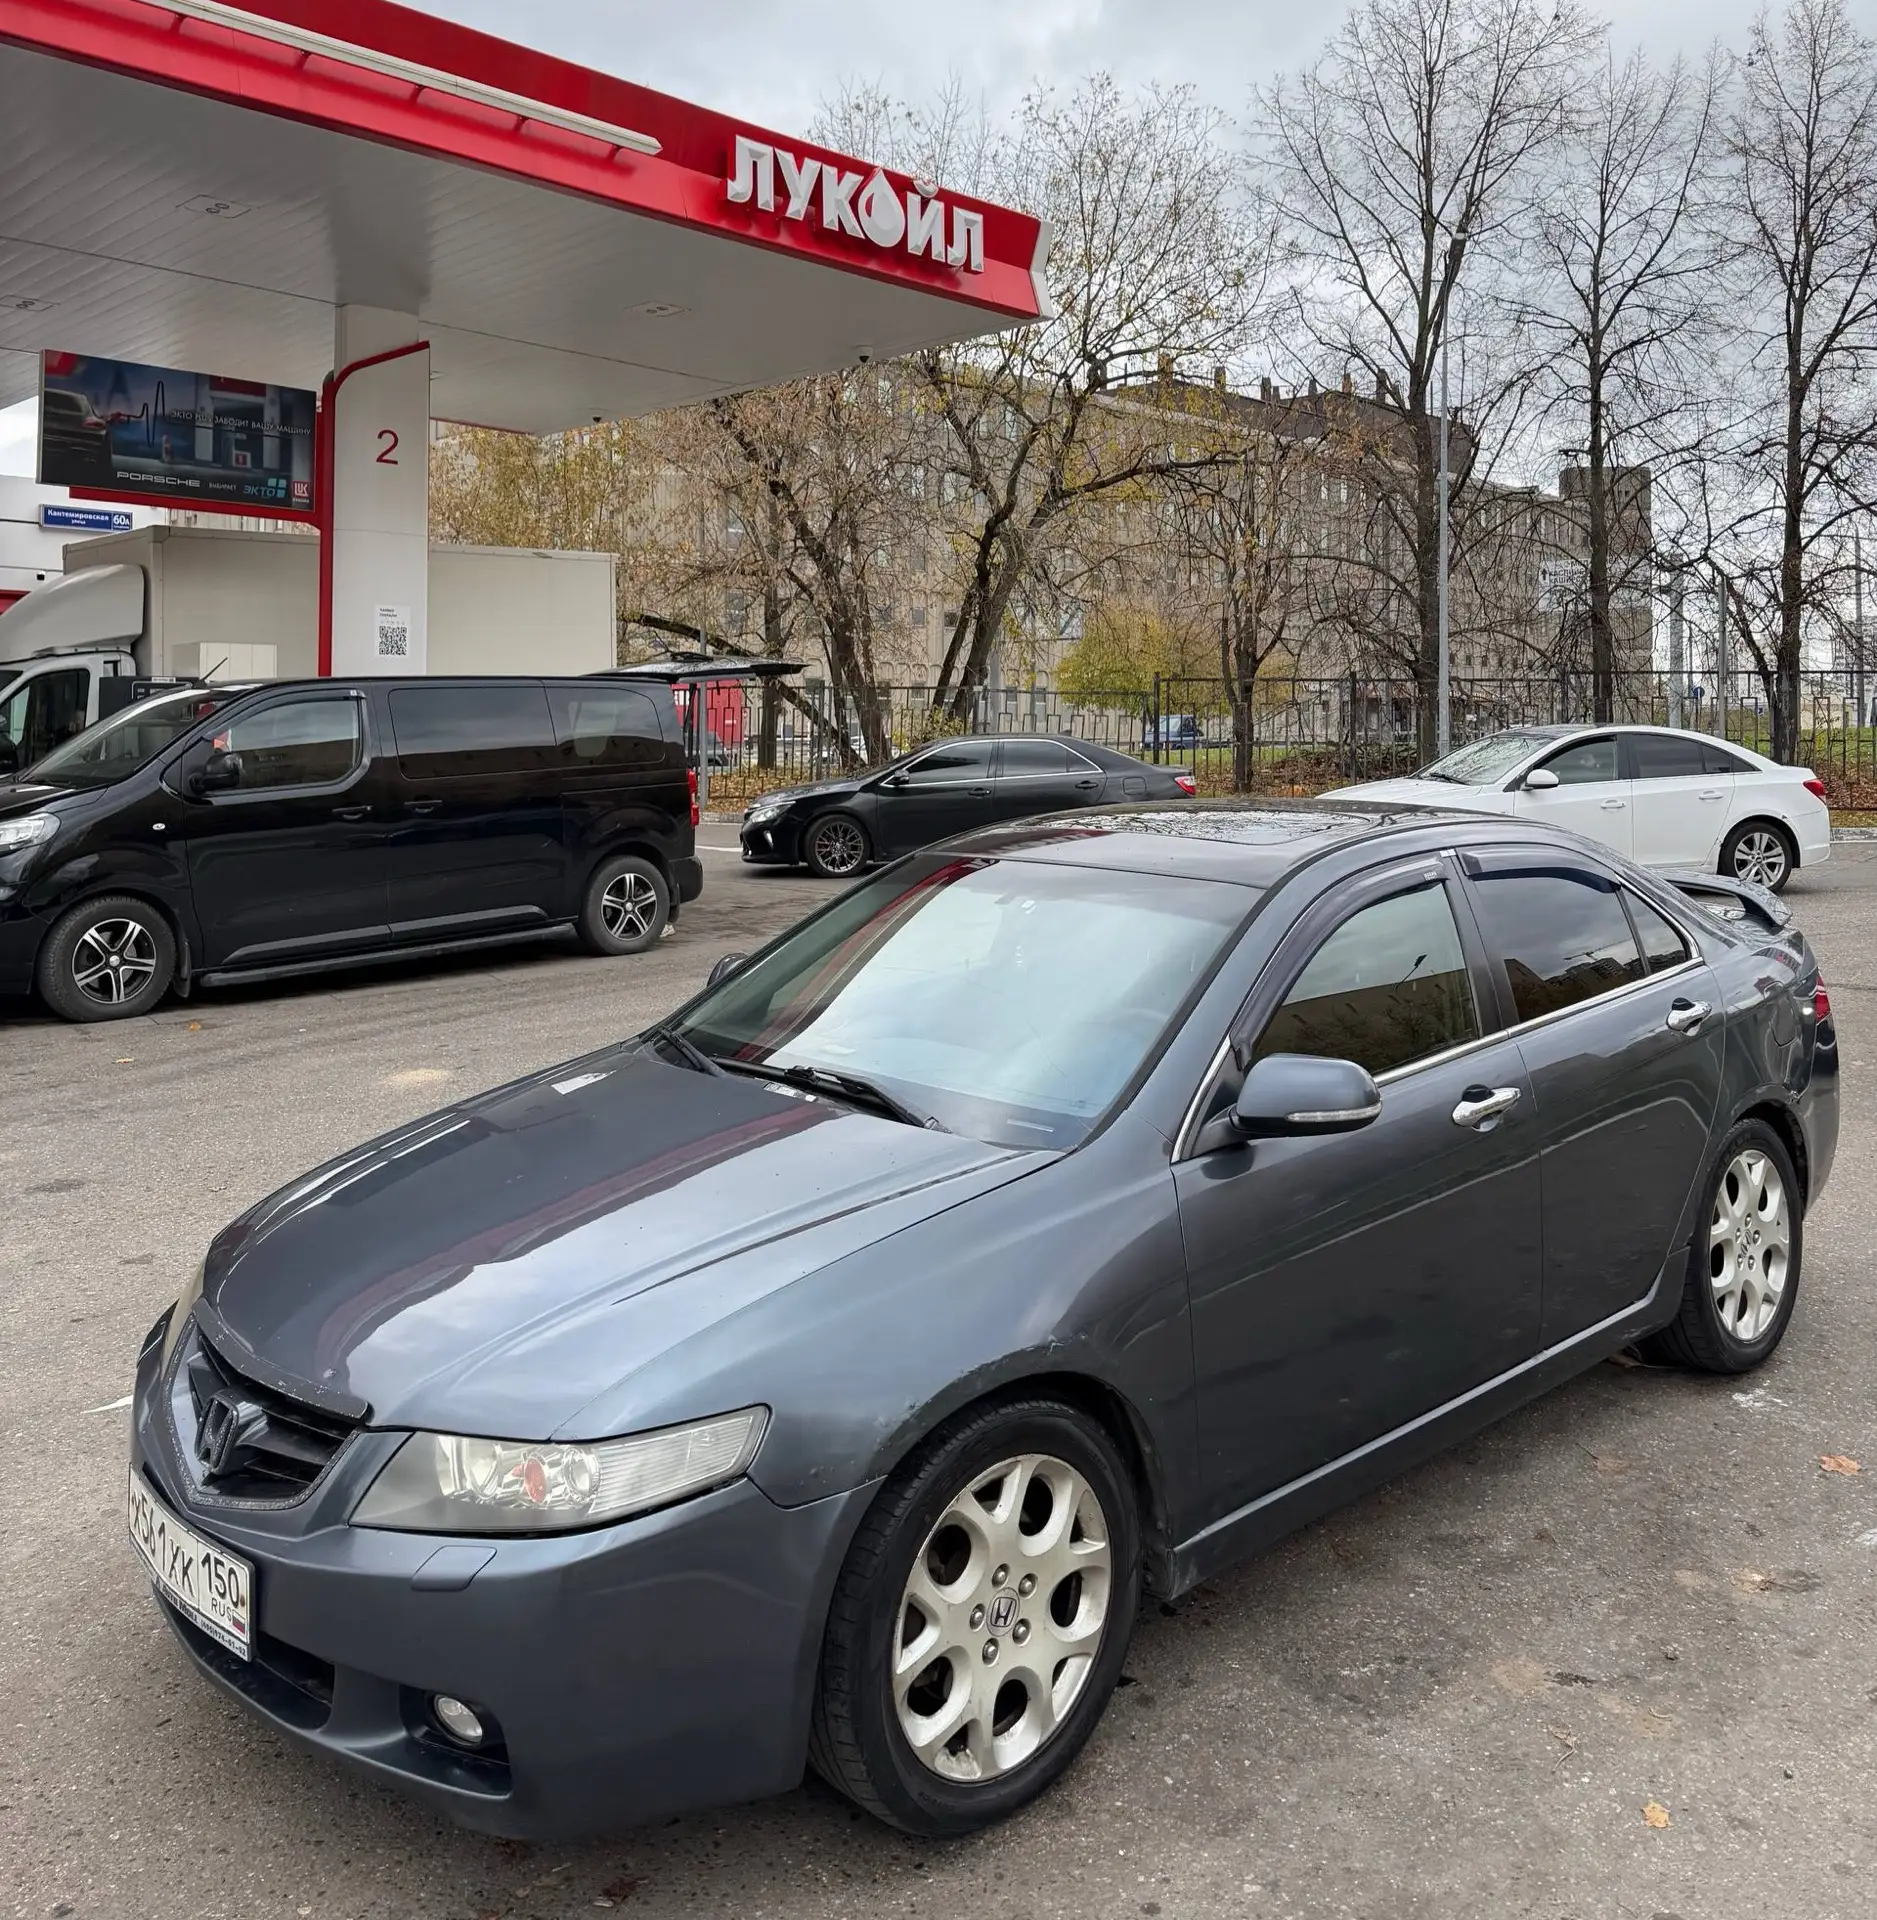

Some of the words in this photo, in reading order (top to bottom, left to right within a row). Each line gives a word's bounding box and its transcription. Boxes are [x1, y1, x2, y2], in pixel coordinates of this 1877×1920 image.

[726, 134, 985, 273] ЛУКОЙЛ
[214, 415, 249, 427] ЗАВОДИТ
[251, 421, 274, 431] ВАШУ
[376, 428, 400, 466] 2
[116, 471, 201, 488] PORSCHE
[243, 484, 276, 499] ЭКТО
[47, 508, 109, 521] Кантемировская
[201, 1551, 240, 1609] 150
[211, 1598, 233, 1623] RUS
